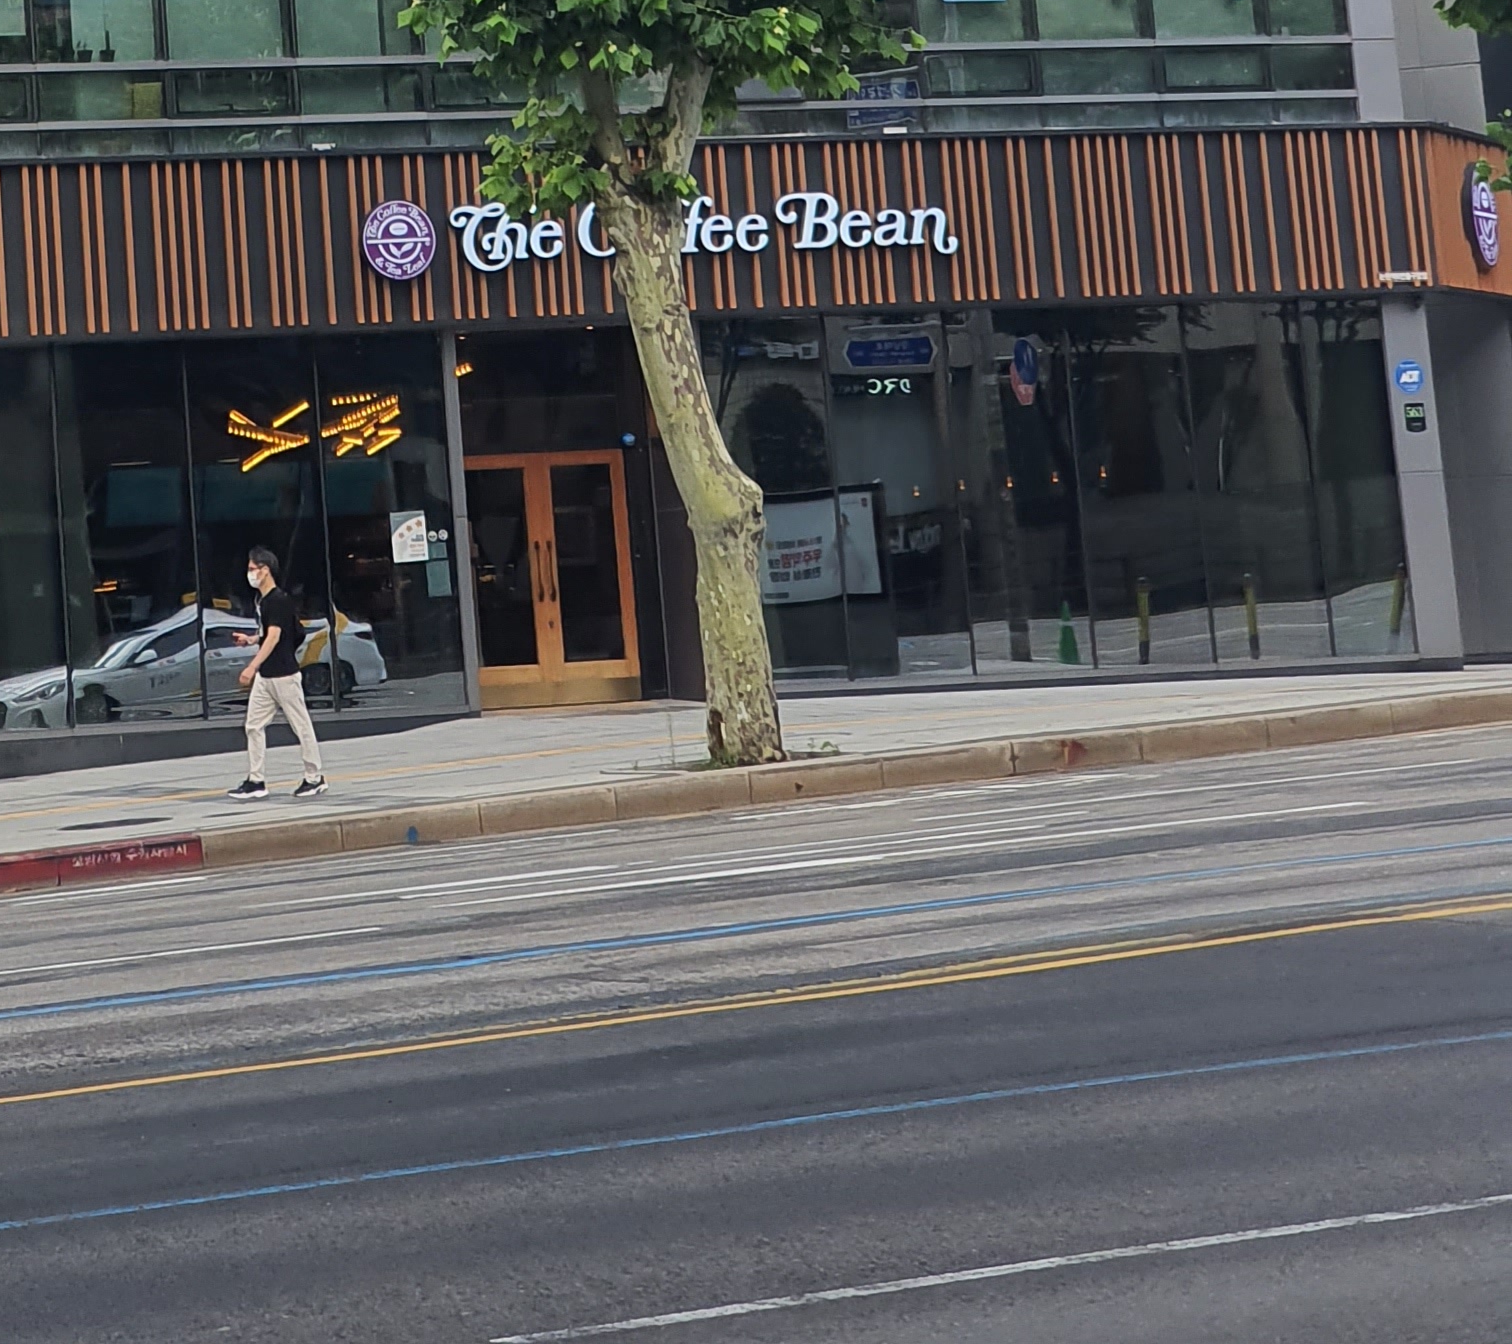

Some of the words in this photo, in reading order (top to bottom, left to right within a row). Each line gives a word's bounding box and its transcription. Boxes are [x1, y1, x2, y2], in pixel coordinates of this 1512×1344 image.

[449, 200, 564, 272] The
[578, 196, 769, 258] Cfee
[775, 192, 959, 255] Bean
